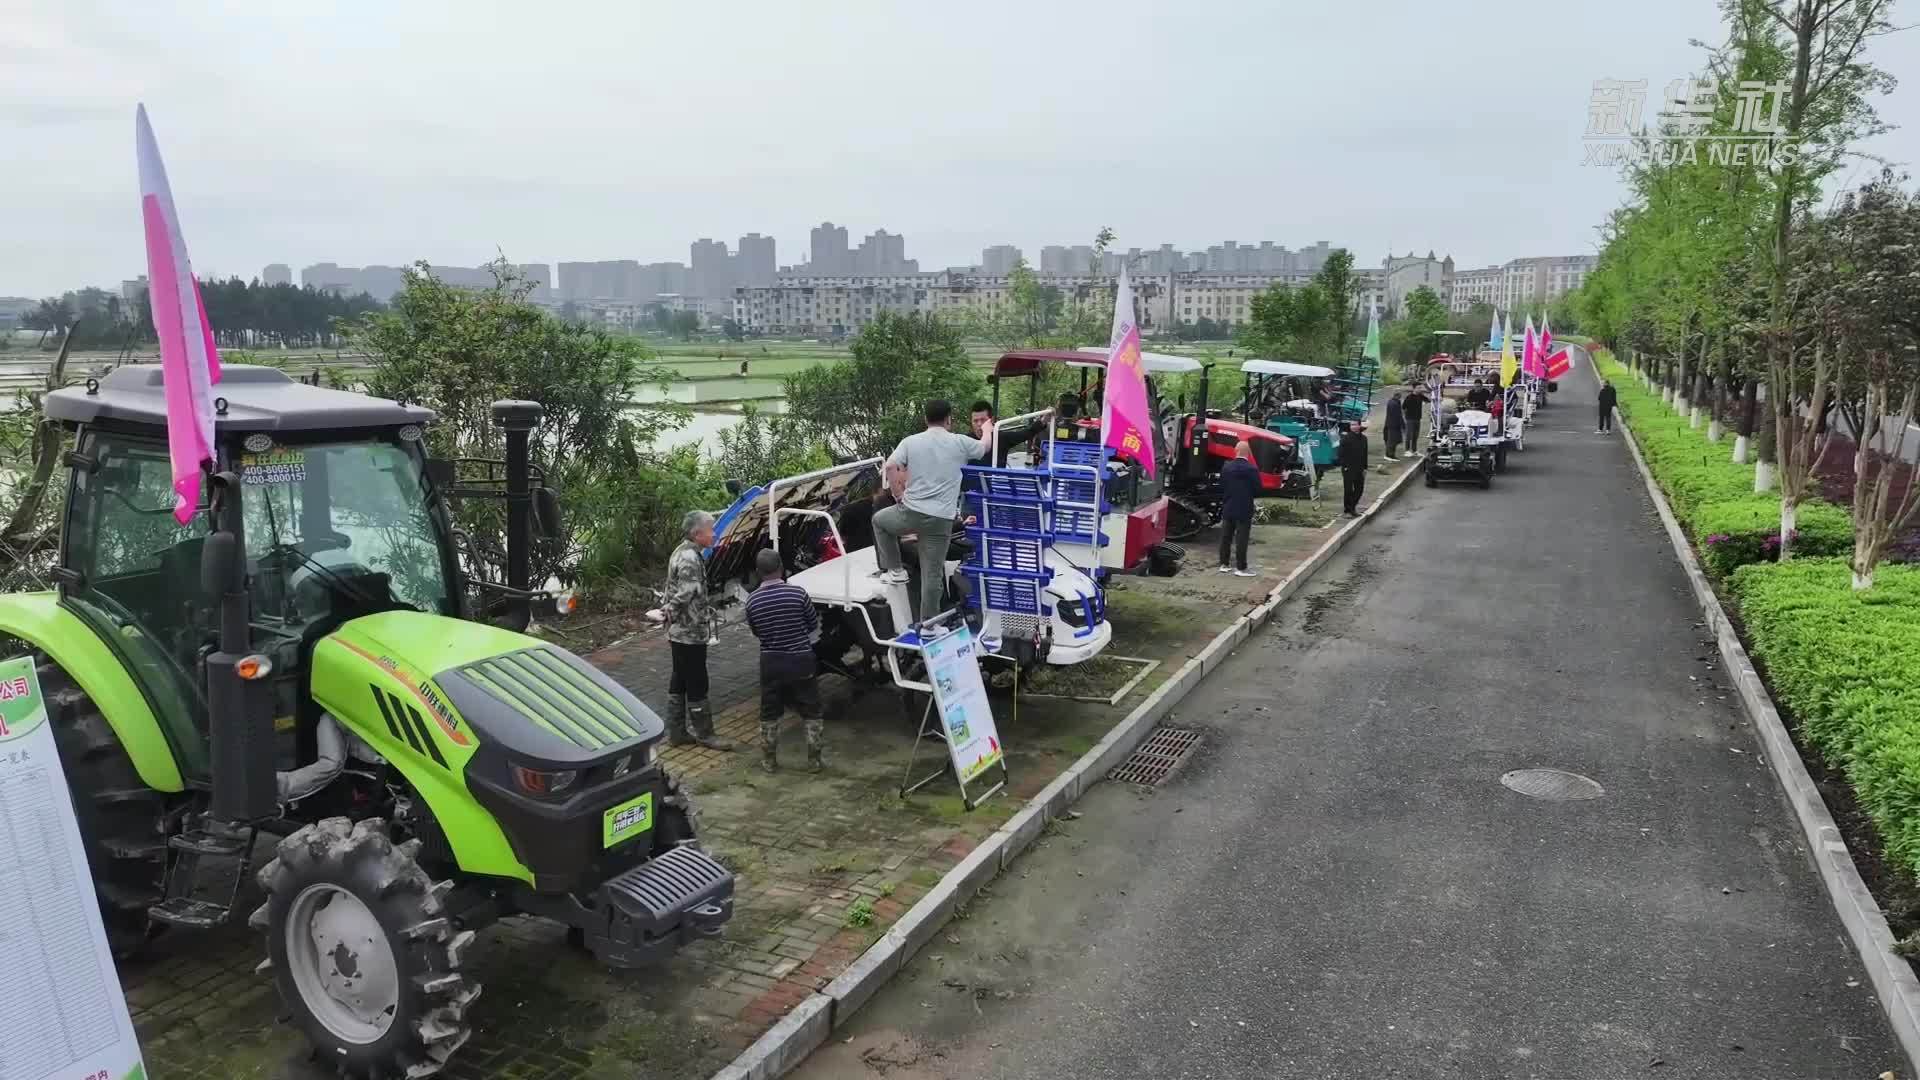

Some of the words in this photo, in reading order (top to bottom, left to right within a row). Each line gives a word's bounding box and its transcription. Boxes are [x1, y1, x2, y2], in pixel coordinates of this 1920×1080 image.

[245, 463, 305, 475] 400-8005151
[247, 471, 306, 484] 400-8000157
[0, 677, 30, 699] 公司
